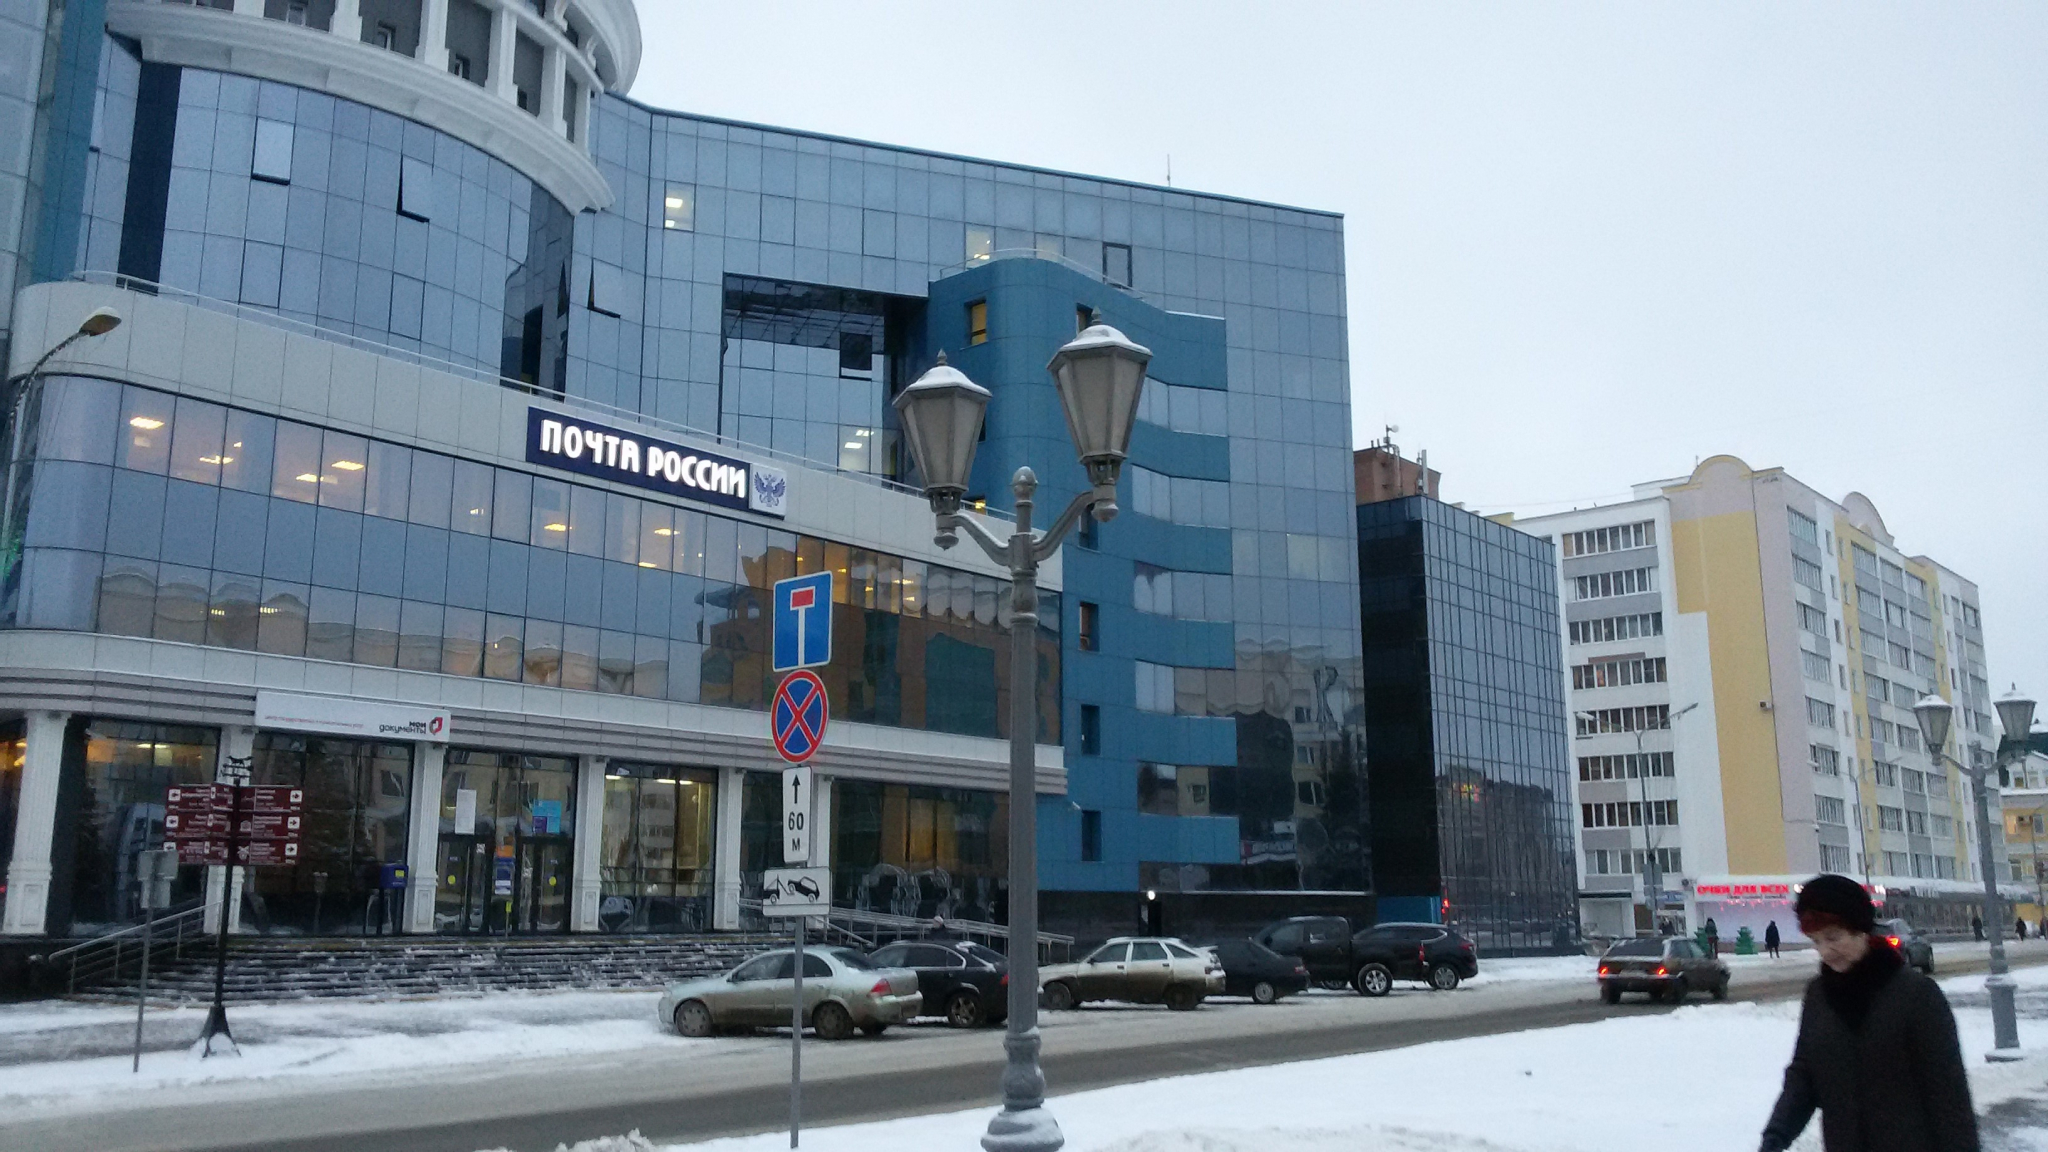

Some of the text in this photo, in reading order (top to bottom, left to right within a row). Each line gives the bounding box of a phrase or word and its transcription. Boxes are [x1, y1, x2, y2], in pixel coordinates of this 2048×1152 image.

[540, 419, 746, 498] ПОЧТА РОССИИ
[788, 812, 804, 831] 60
[1697, 884, 1730, 895] ОЧКИ
[1733, 884, 1757, 895] ДЛЯ
[1760, 884, 1789, 895] ВСЕХ
